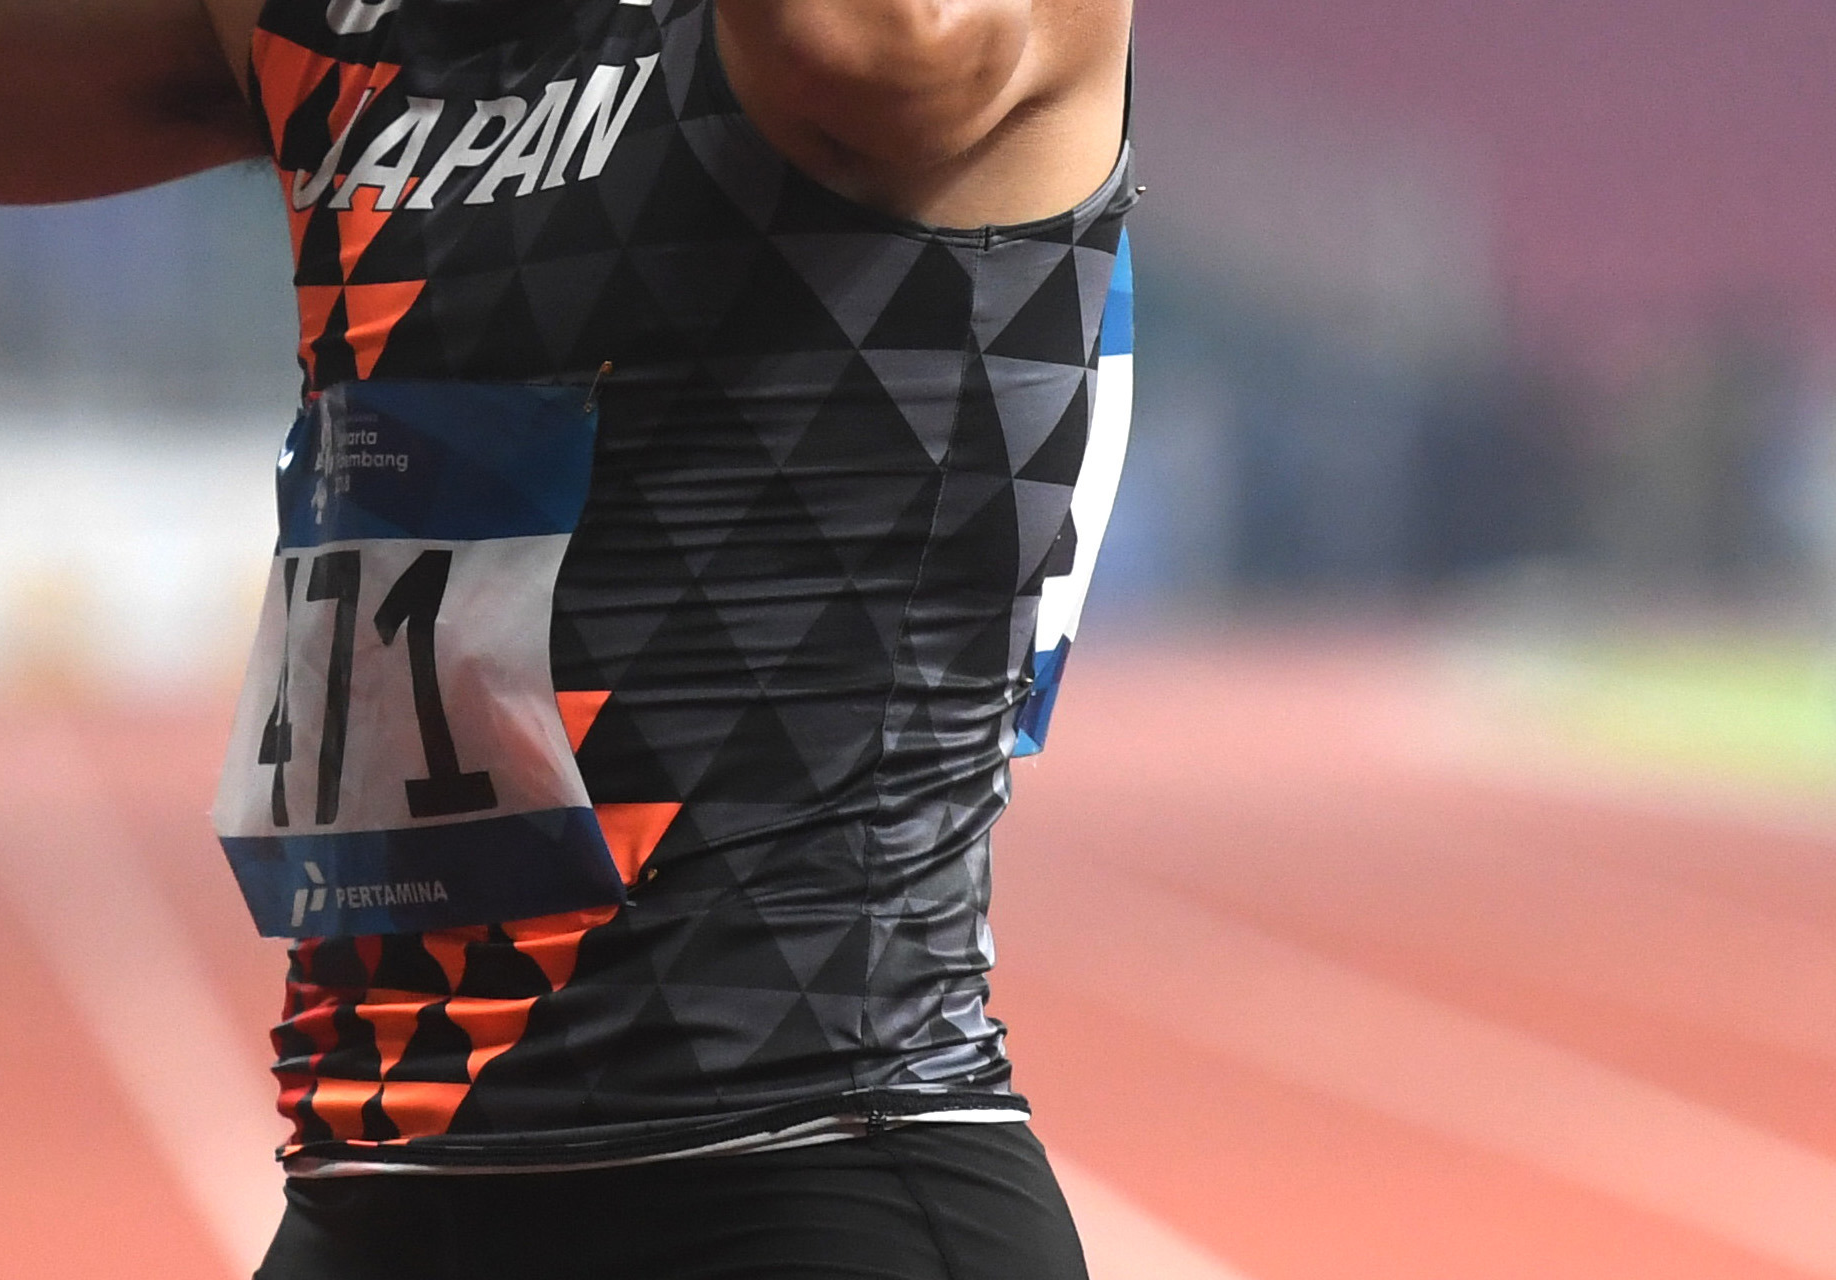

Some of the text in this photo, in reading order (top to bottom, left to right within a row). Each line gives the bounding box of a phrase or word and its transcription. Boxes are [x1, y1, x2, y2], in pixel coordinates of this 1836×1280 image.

[293, 52, 660, 211] JAPAN
[258, 549, 498, 827] 471
[335, 880, 448, 909] PERTAMINA
